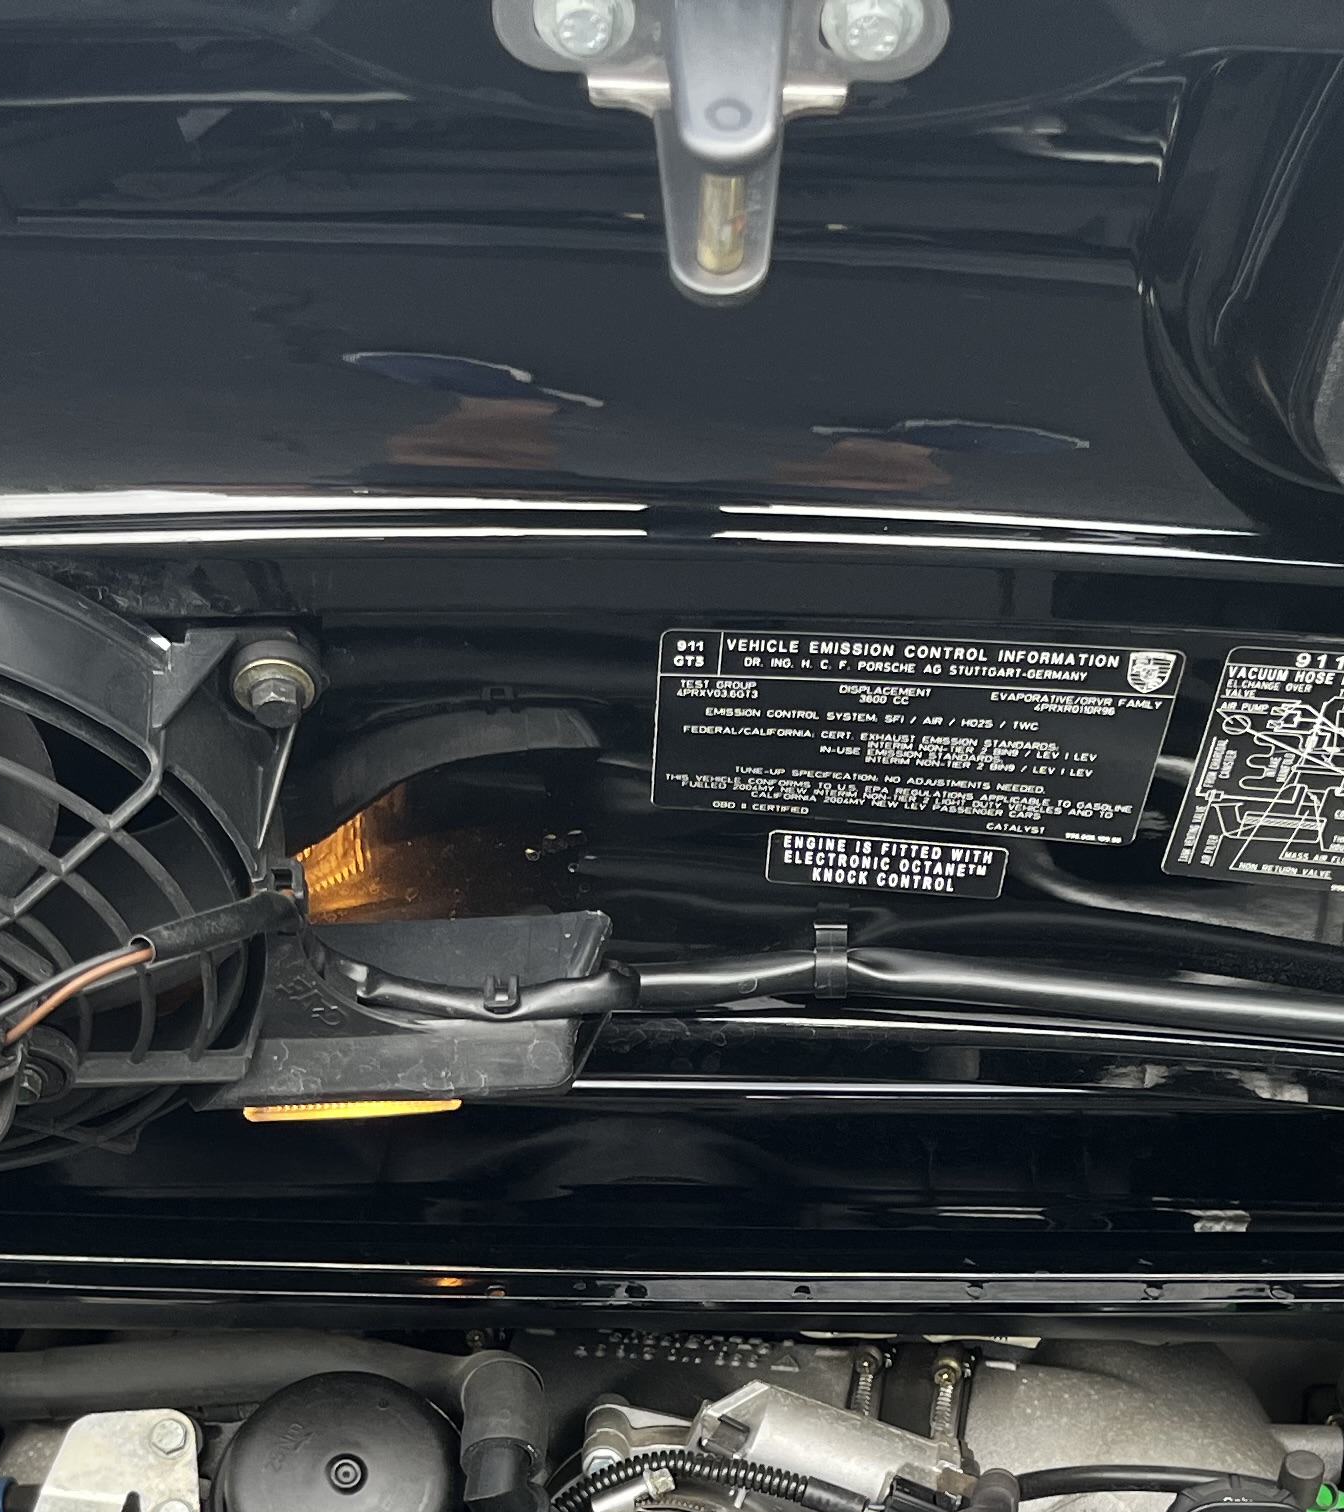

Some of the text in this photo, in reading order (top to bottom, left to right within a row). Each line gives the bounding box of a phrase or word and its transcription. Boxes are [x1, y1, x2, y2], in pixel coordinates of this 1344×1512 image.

[677, 640, 704, 652] 911
[726, 639, 1120, 668] VEHICLE EMISSION CONTROL INFORMATION
[674, 656, 704, 667] GT3
[744, 657, 1087, 681] DR. ING. H. C. F. PORSCHE AG STUTTGART-GERMANY
[1228, 666, 1290, 682] VACUUM
[1294, 670, 1336, 685] HOSE
[680, 680, 757, 689] TEST GROUP
[839, 685, 932, 698] DISPLACEMENT
[1286, 683, 1313, 692] OVER
[1225, 689, 1256, 697] VALVE
[893, 696, 910, 705] CC
[1118, 699, 1162, 710] FAMILY
[1221, 703, 1269, 713] AIR PUMP
[705, 708, 761, 718] EMISSION
[767, 710, 819, 720] CONTROL
[884, 714, 905, 723] SFI
[923, 717, 943, 726] AIR
[1013, 722, 1039, 731] TWC
[860, 732, 916, 743] EXHAUST
[922, 736, 978, 746] EMISSION
[819, 746, 922, 759] IN-USE EMISSION
[1036, 751, 1060, 760] LEV
[1073, 753, 1097, 762] LEV
[865, 756, 913, 766] INTERIM
[977, 762, 984, 771] 2
[1032, 766, 1055, 775] LEV
[1069, 768, 1093, 777] LEV
[735, 766, 785, 776] TUNE-UP
[885, 775, 901, 783] NO
[907, 777, 991, 790] ADJUSTMENTS
[665, 774, 1133, 814] THIS VEHICLE CONFORMS TO EPA REGULATIONS APPLICABLE TO GASOLINE
[712, 800, 809, 815] OBD CERTIFIED
[781, 786, 807, 795] NEW
[1008, 802, 1062, 815] VEHICLES
[1068, 808, 1093, 817] AND
[1100, 810, 1114, 819] TO
[871, 799, 898, 808] NEW
[932, 804, 1003, 817] PASSENGER
[1009, 810, 1041, 820] CARS
[986, 822, 1045, 834] CATALYST
[783, 835, 994, 865] ENGINE IS FITTED WITH
[1284, 851, 1309, 861] MASS
[1313, 854, 1328, 863] AIR
[784, 850, 891, 870] ELECTRONIC
[1239, 862, 1332, 879] NON RETURN VALVE
[812, 868, 955, 892] KNOCK CONTROL
